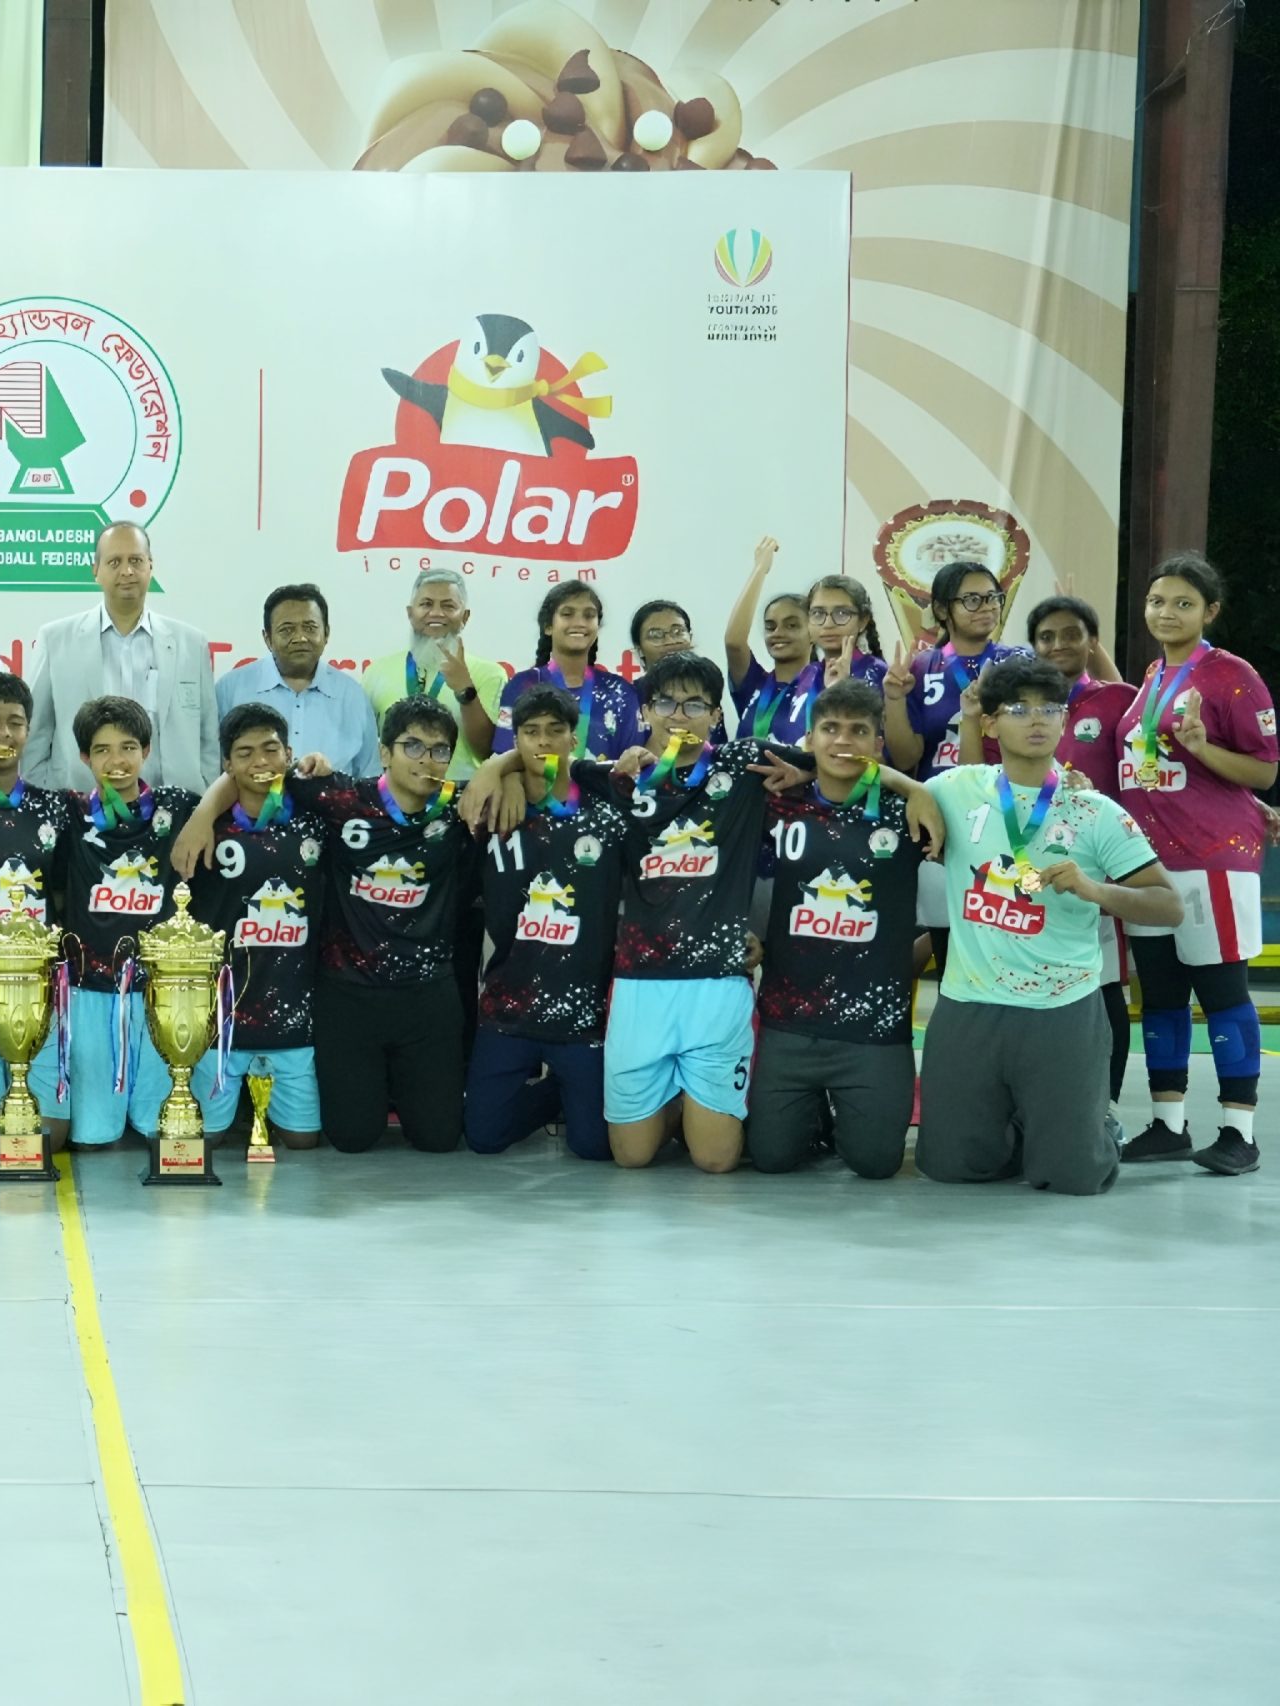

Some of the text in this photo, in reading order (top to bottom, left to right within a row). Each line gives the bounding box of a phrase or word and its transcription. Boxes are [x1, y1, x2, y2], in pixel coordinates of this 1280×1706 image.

[101, 333, 172, 463] ফেডারেশন
[356, 457, 624, 545] Polar
[41, 551, 96, 566] FEDERAT
[363, 555, 597, 583] ice cream
[923, 672, 945, 706] 5
[341, 818, 372, 849] 6
[770, 819, 807, 861] 10
[966, 803, 991, 843] 1
[215, 839, 246, 878] 9
[487, 831, 525, 872] 11
[642, 852, 713, 879] Polar
[94, 887, 161, 912] Polar
[355, 879, 425, 905] Polar
[793, 908, 872, 937] Polar
[967, 892, 1042, 930] Polar
[240, 920, 306, 944] Polar
[733, 1056, 751, 1090] 5
